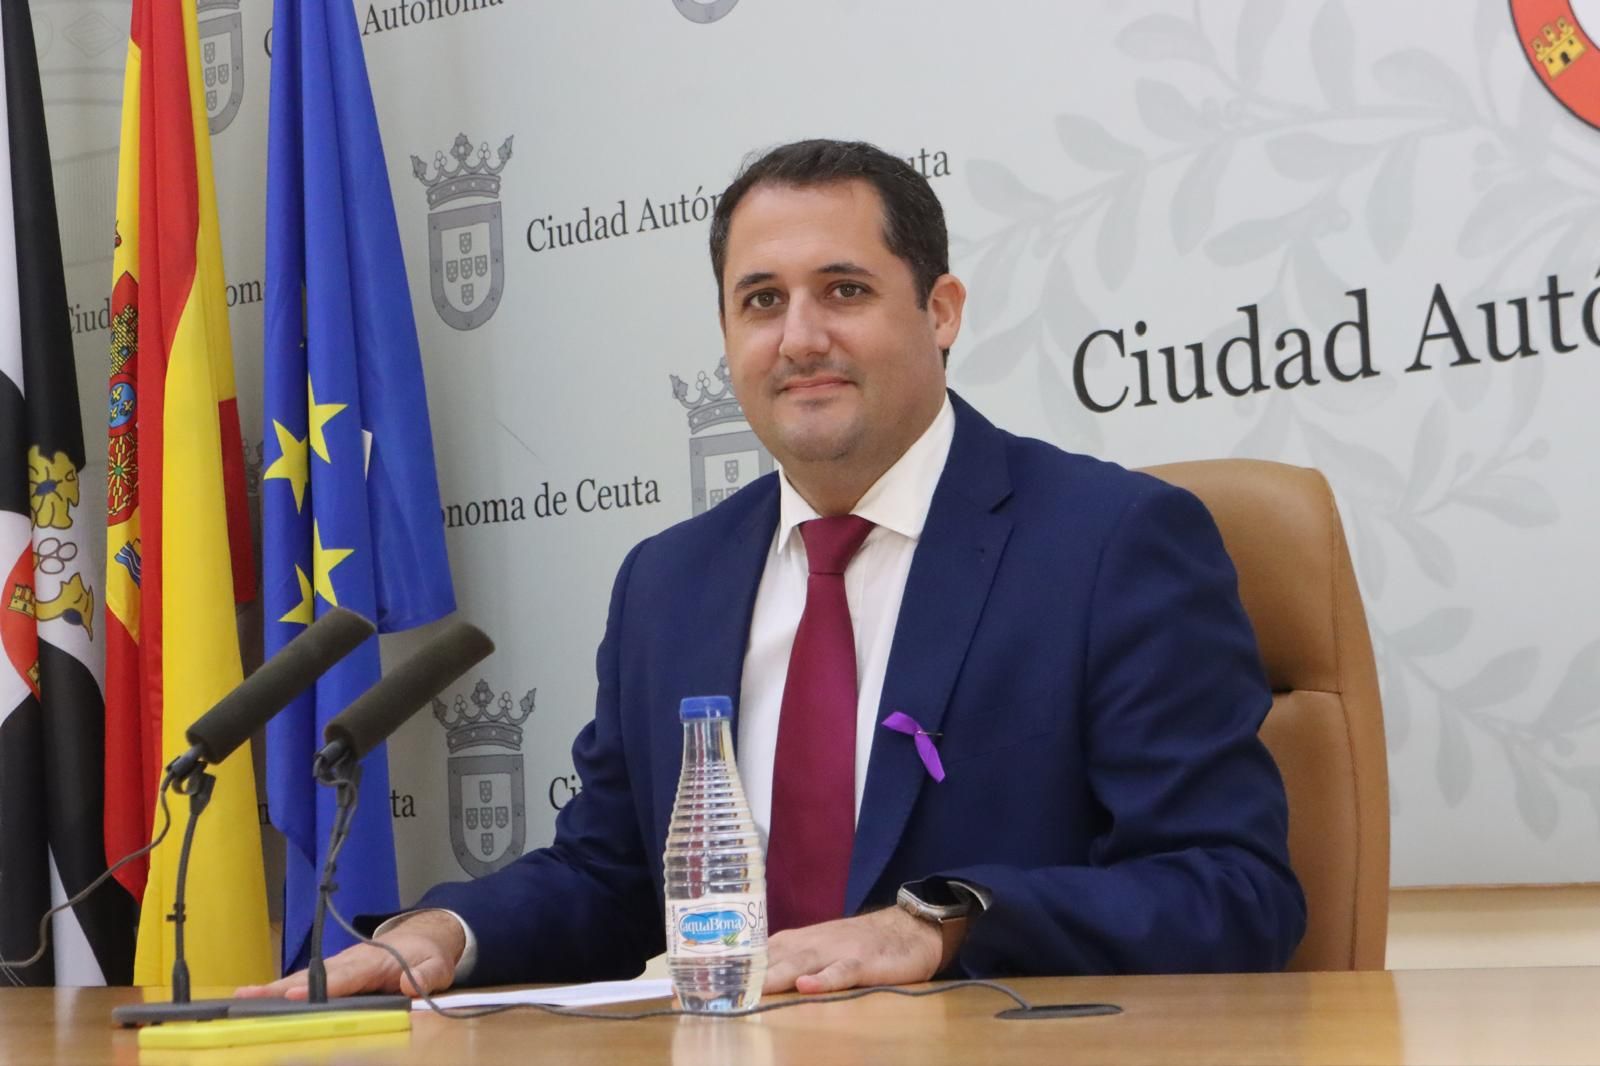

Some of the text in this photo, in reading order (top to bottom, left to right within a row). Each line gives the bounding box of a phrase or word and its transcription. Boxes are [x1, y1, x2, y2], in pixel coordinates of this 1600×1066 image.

[526, 200, 629, 252] Ciudad
[1072, 287, 1381, 413] Ciudad
[440, 475, 661, 529] noma de Ceuta
